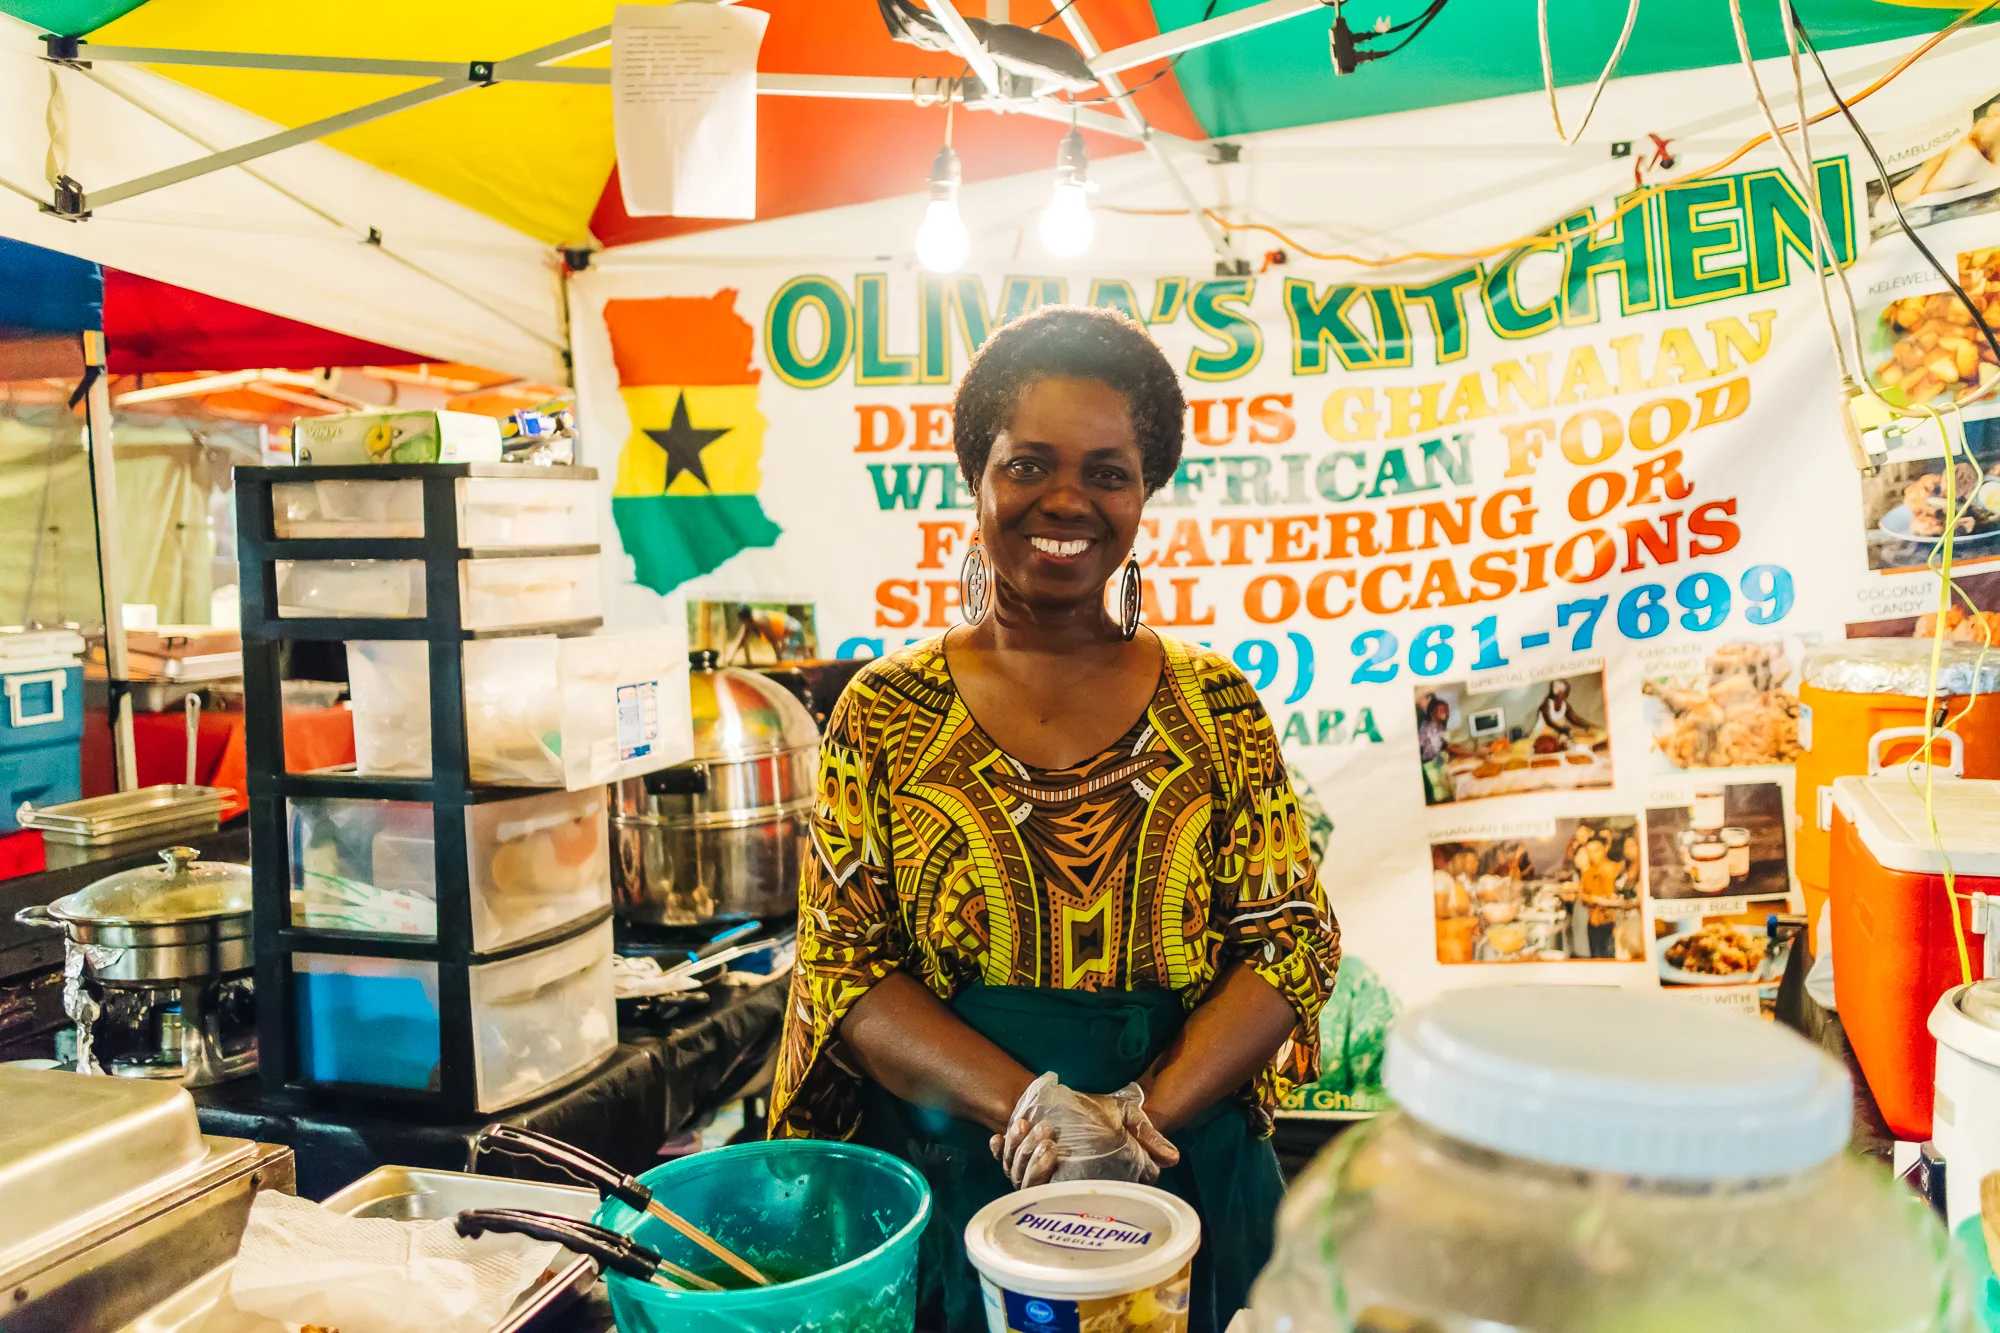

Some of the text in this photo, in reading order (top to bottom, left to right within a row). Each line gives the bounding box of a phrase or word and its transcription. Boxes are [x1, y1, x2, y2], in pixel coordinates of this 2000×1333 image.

[1283, 154, 1857, 376] KITCHEN
[1322, 309, 1777, 443] GHANAIAN
[866, 462, 978, 511] WE
[1499, 376, 1752, 479] FOOD
[1567, 448, 1695, 523] OR
[1243, 497, 1741, 625] OCCASIONS
[1857, 582, 1934, 601] COCONUT
[1871, 600, 1924, 616] CANDY
[1350, 563, 1795, 685] 261-7699
[1470, 671, 1523, 689] SPECIAL
[1709, 898, 1743, 912] RICE
[1714, 992, 1751, 1005] WITH
[1016, 1213, 1153, 1245] PHILADELPHIA
